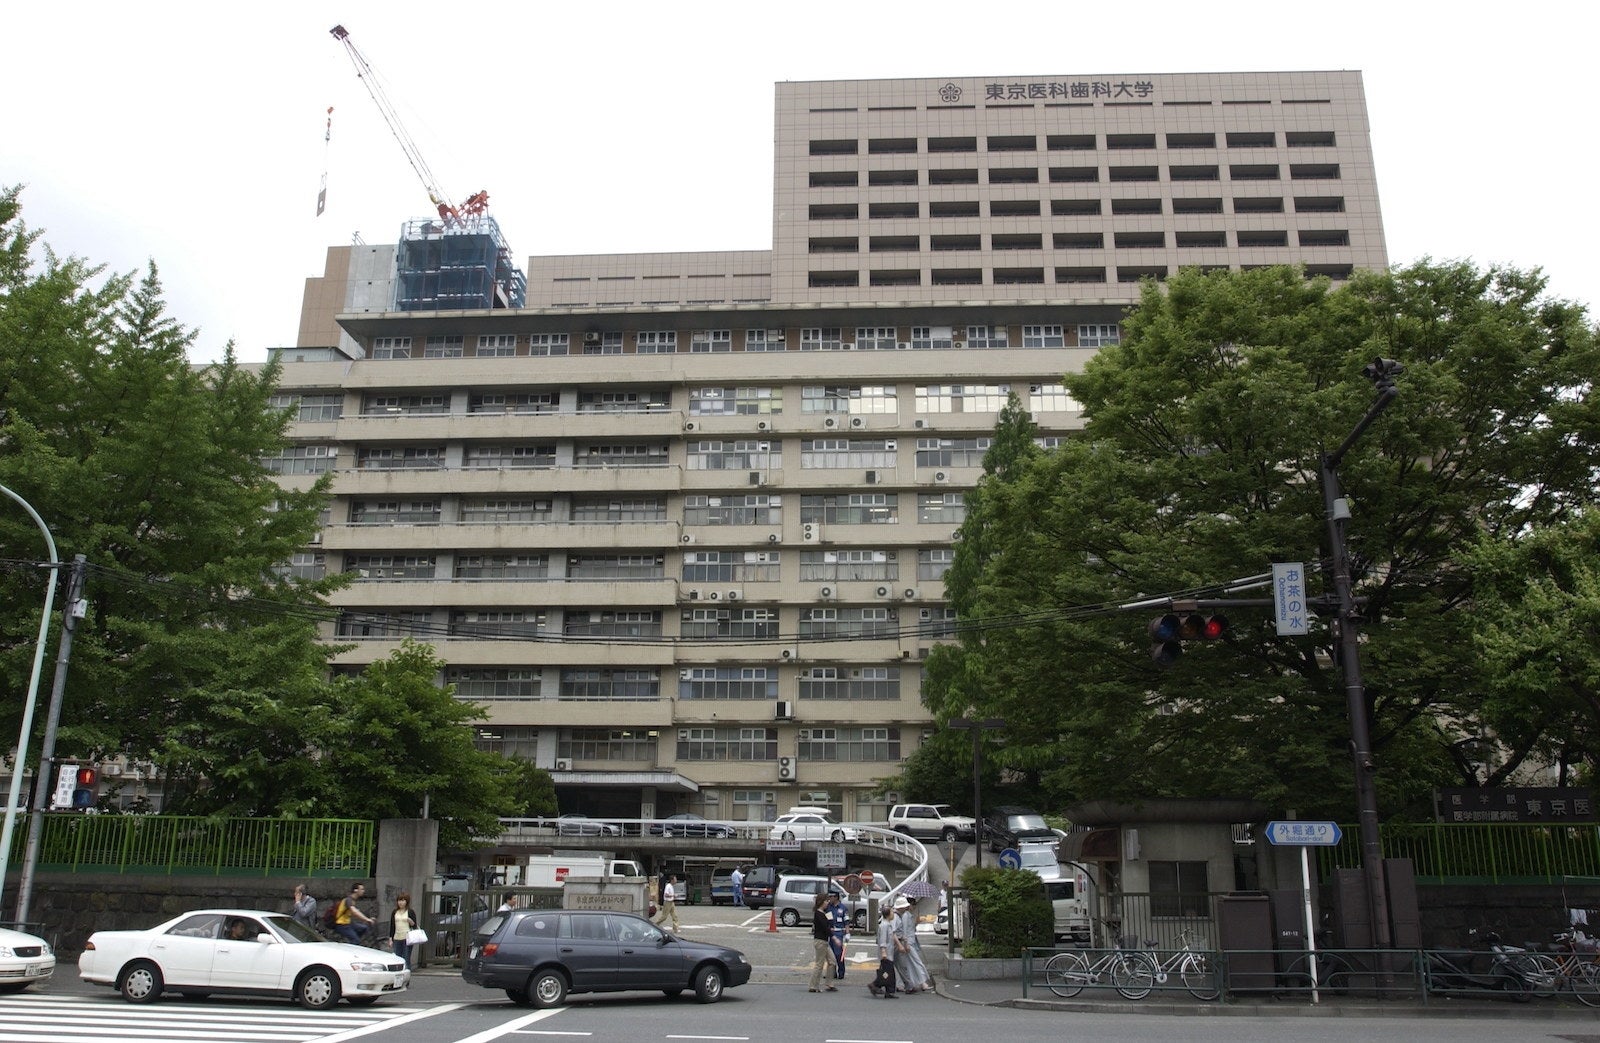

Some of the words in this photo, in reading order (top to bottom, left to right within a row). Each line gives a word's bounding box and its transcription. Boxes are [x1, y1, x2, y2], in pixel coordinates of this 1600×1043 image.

[985, 80, 1154, 101] 東京医科歯科大学
[1278, 578, 1286, 621] Ochanomizu
[1286, 568, 1303, 629] お茶の水
[1525, 799, 1591, 816] 東京医
[1279, 824, 1327, 835] 外堀通り
